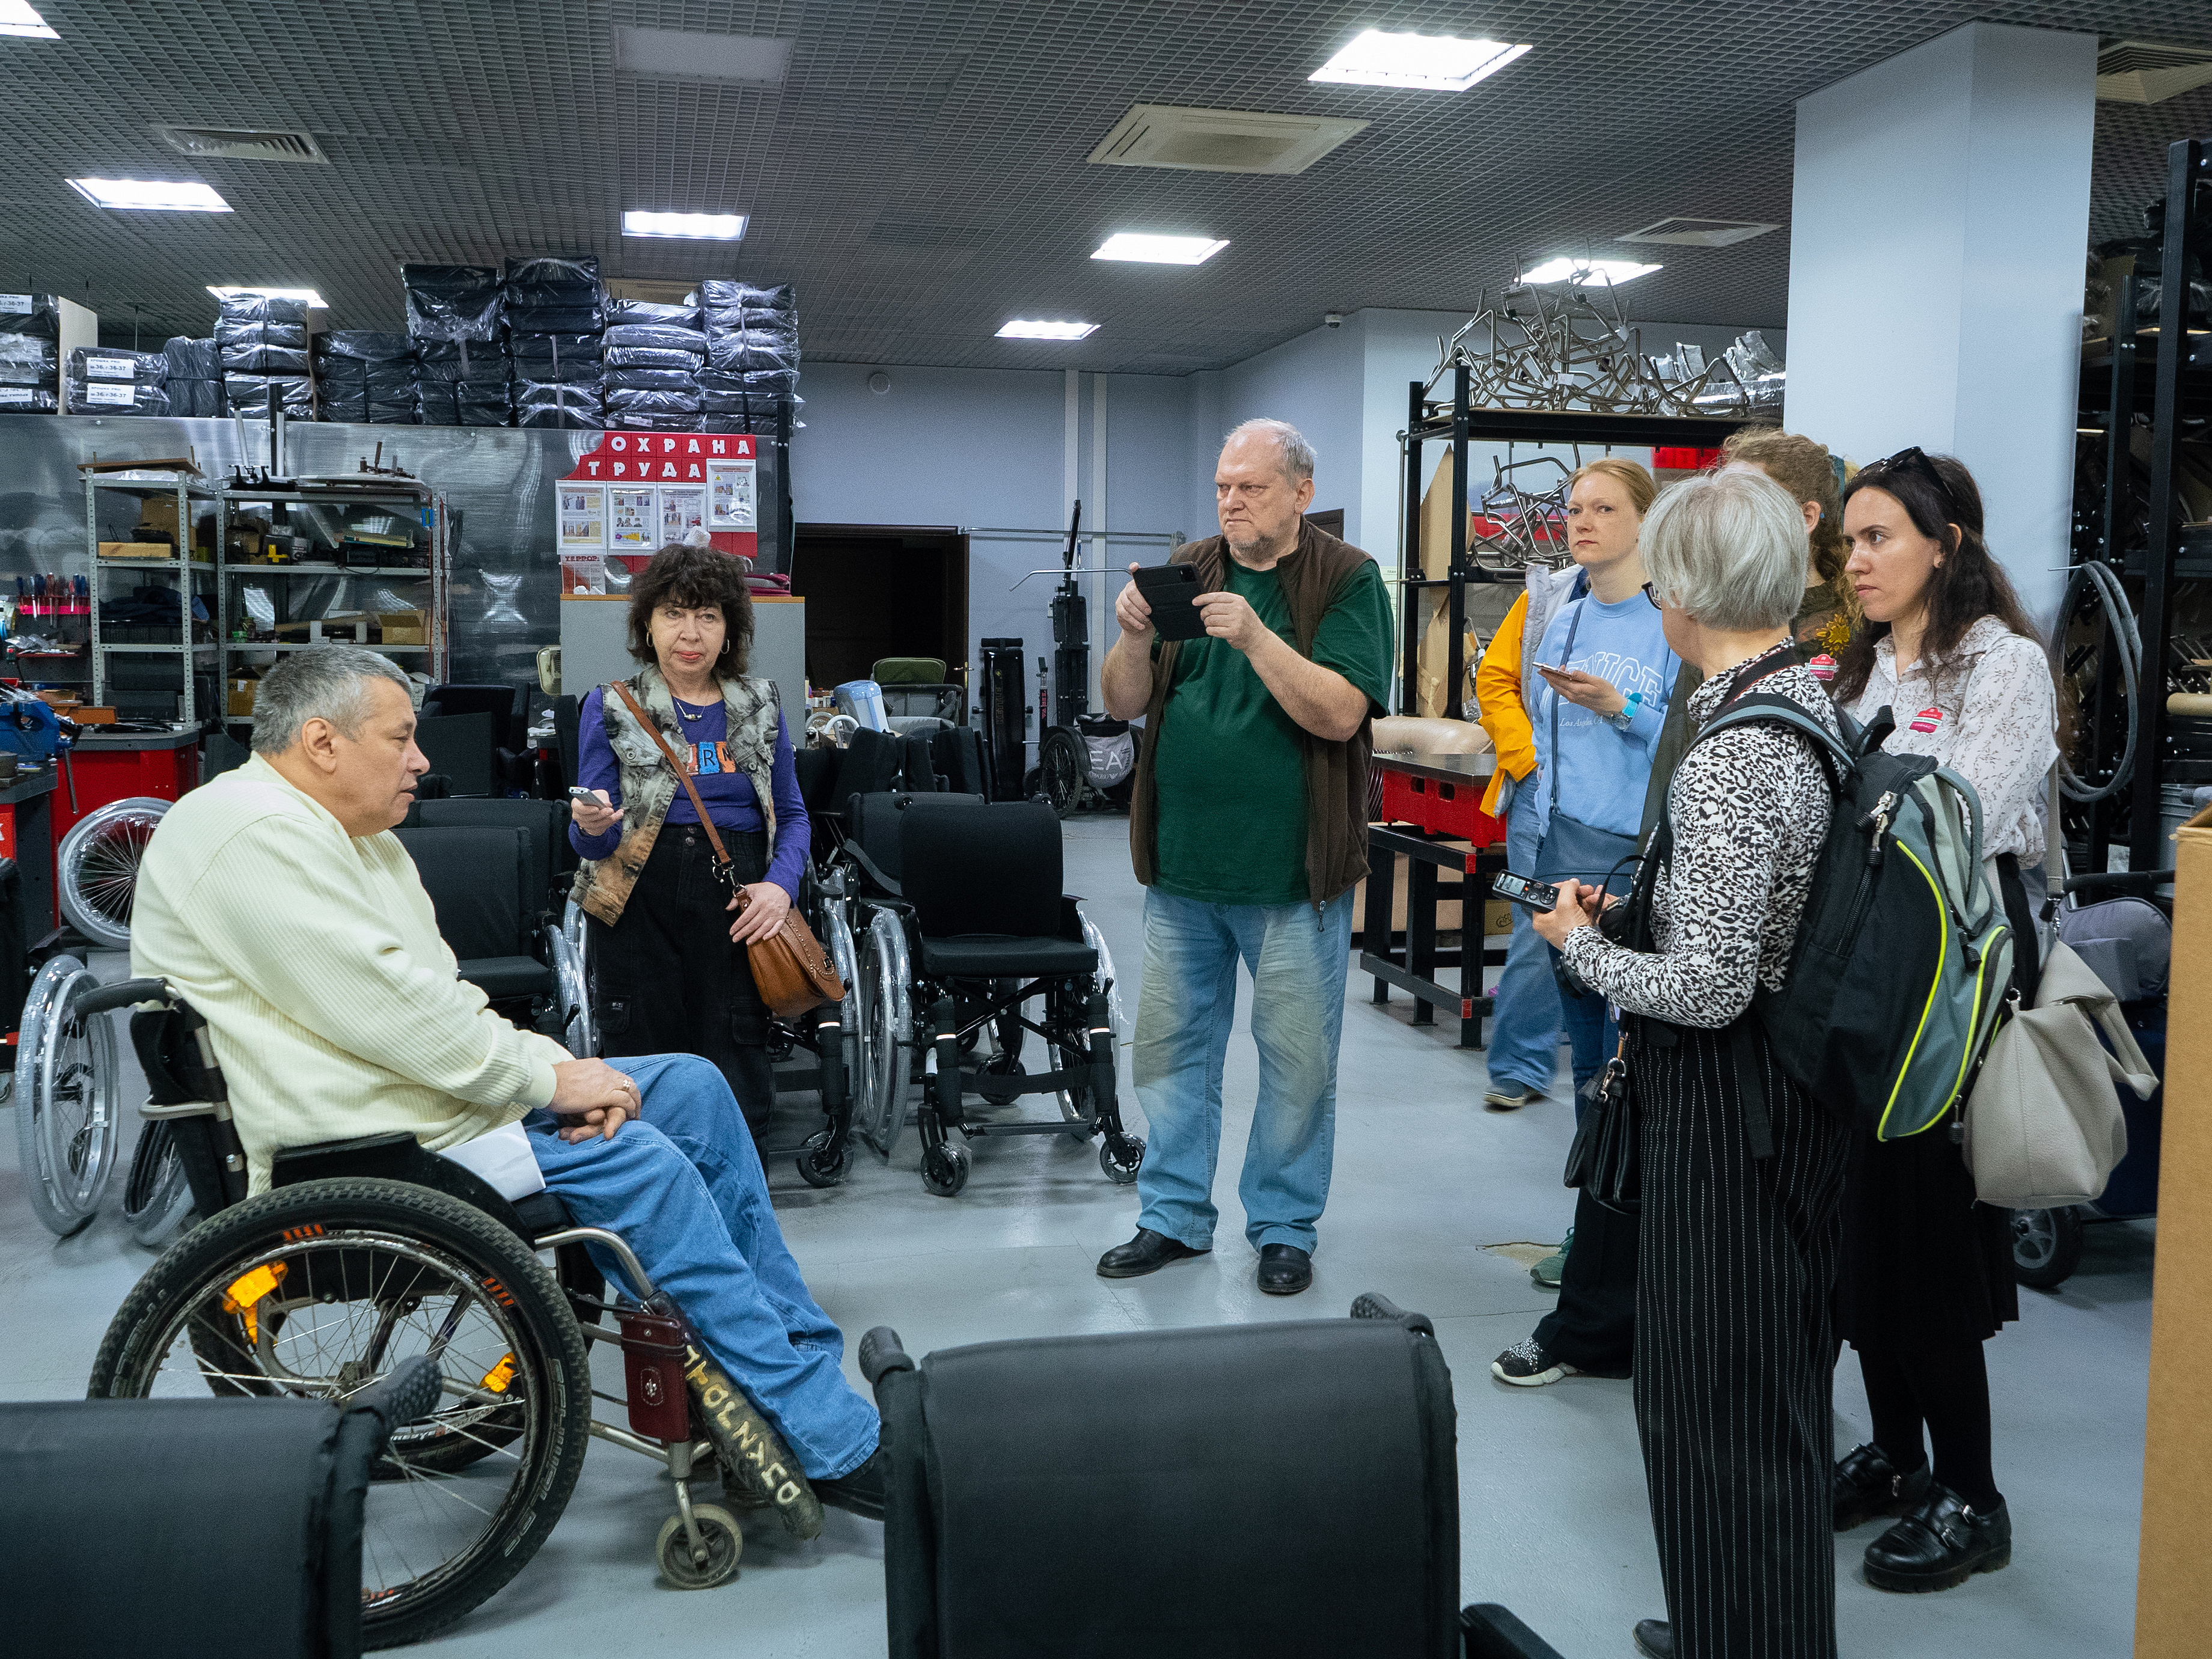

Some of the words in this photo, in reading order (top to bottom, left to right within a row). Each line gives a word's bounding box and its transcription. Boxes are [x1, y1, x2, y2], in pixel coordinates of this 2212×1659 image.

[611, 436, 750, 454] ОХРАНА
[588, 461, 701, 478] ТРУДА
[1559, 718, 1573, 727] Los
